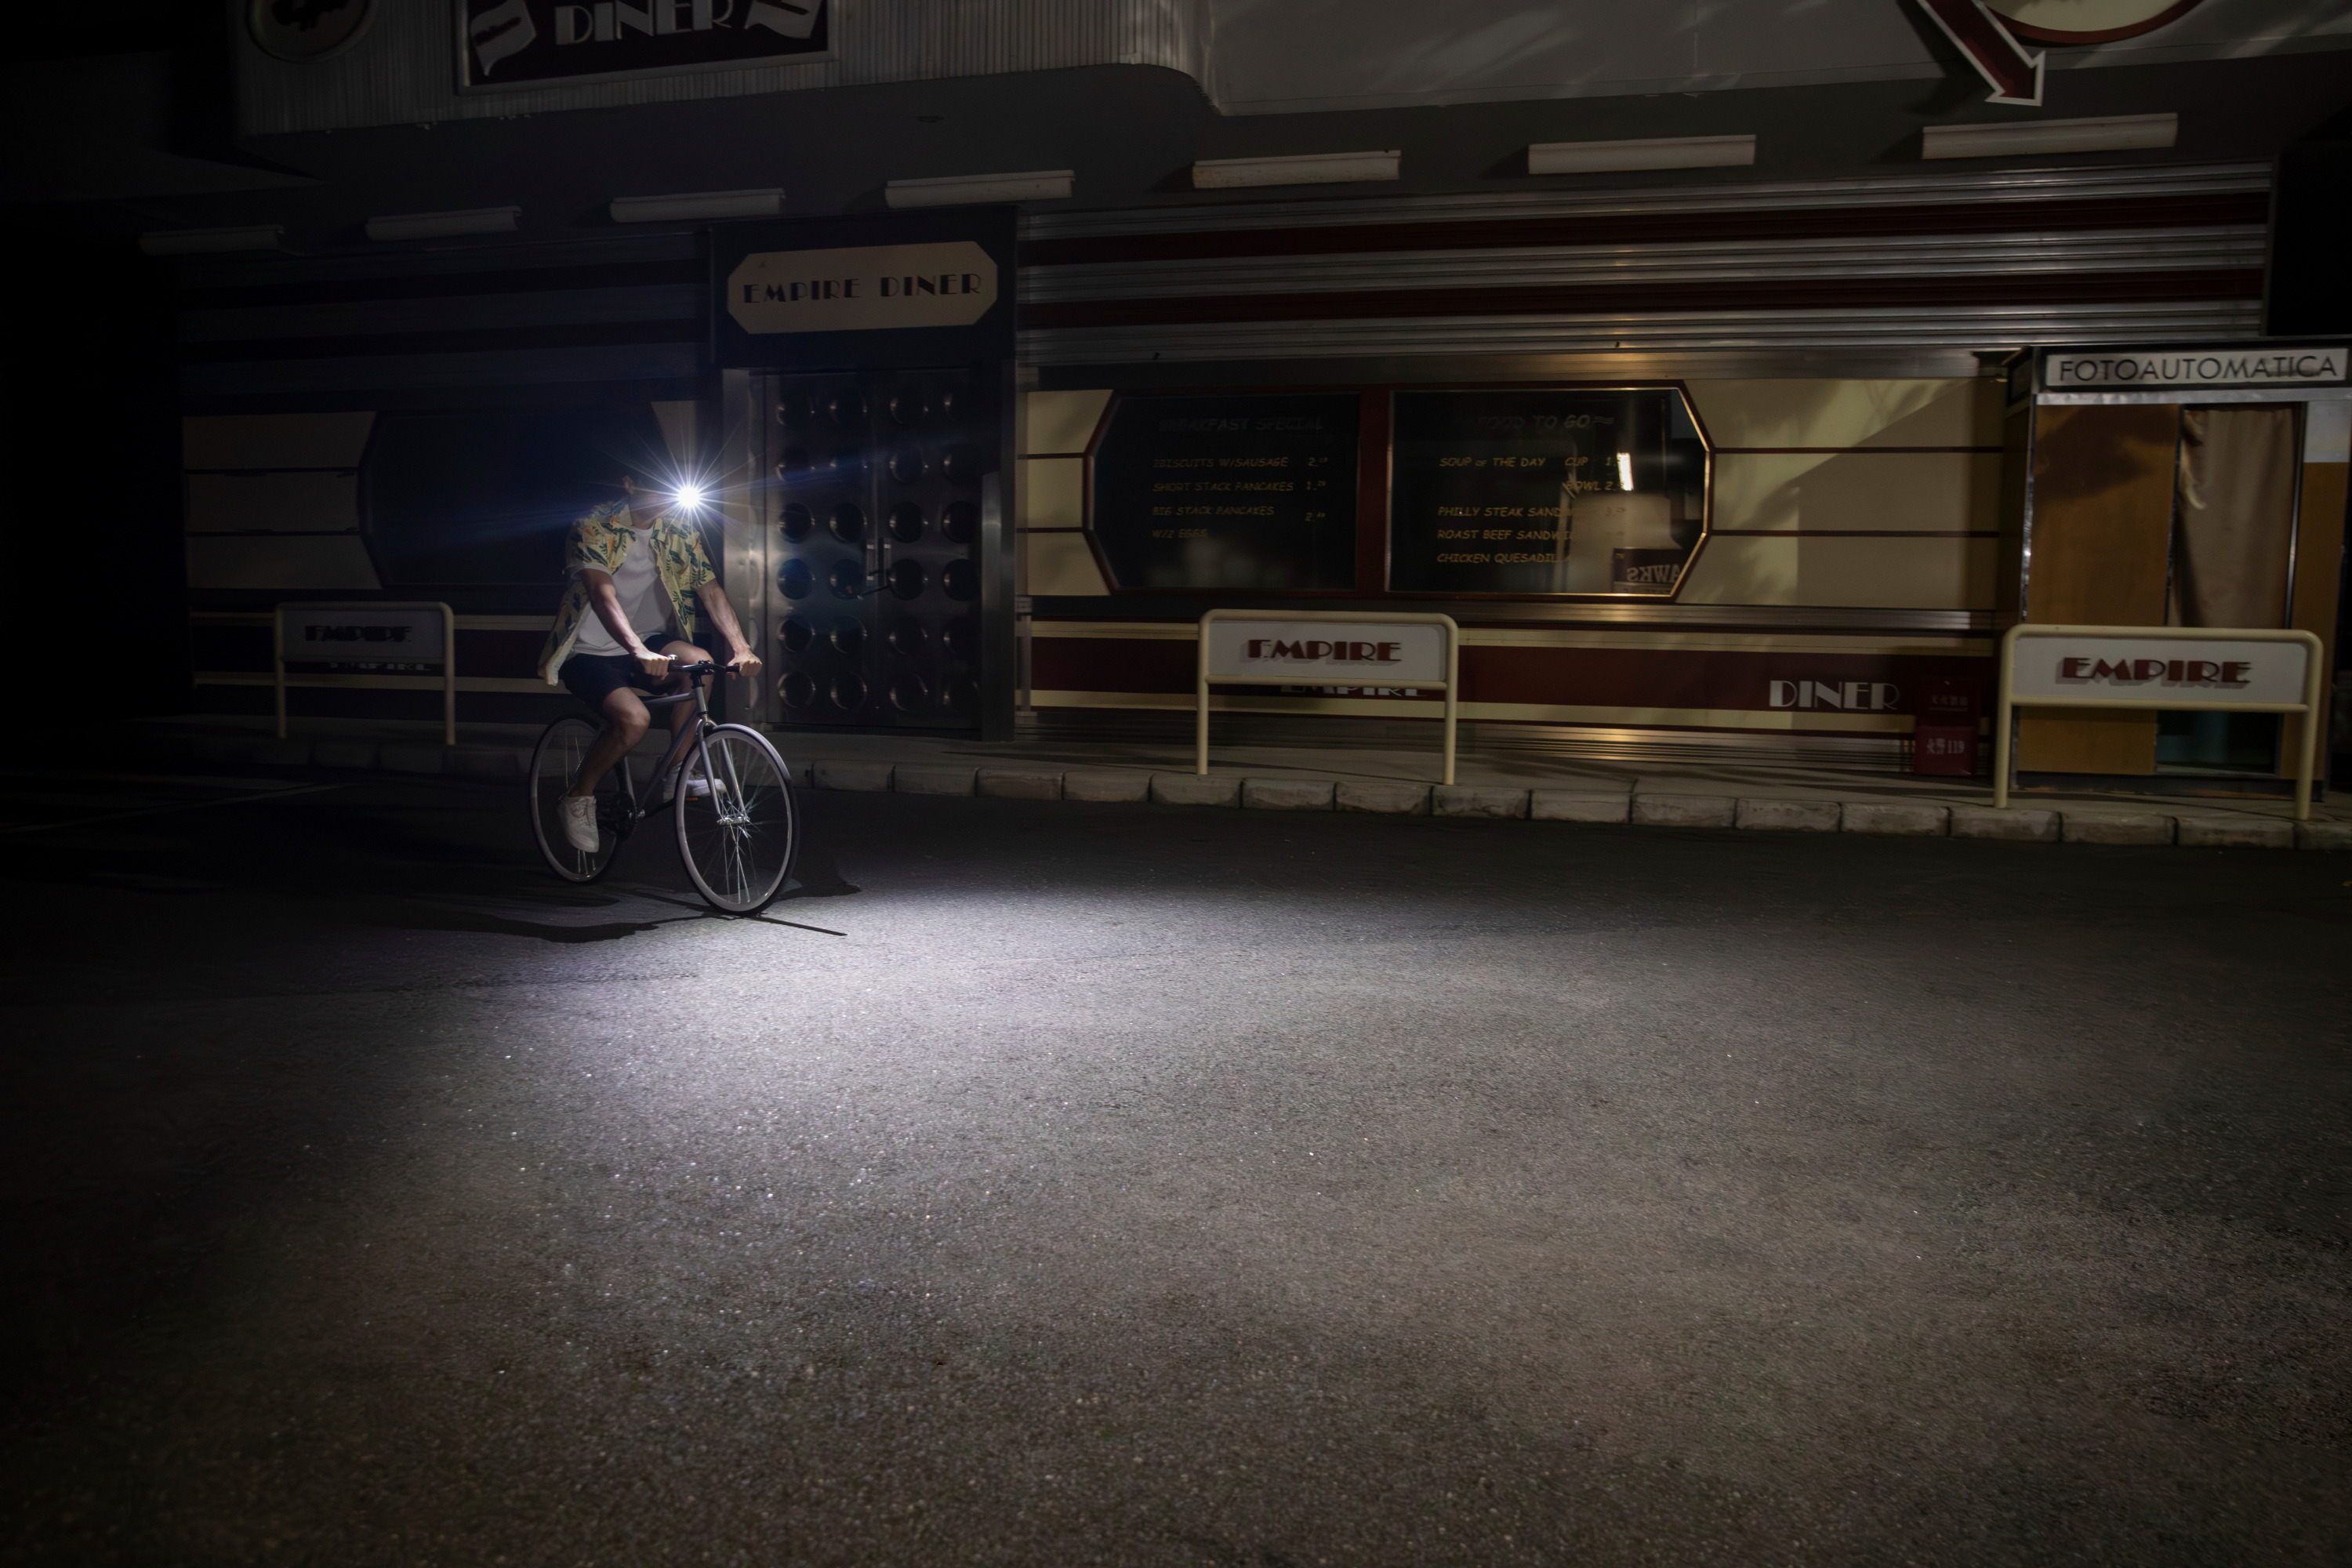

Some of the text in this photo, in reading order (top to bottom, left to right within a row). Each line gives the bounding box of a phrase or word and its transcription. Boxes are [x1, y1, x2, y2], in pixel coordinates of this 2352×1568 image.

[554, 0, 735, 45] DINER
[743, 274, 980, 303] EMPIRE DINER
[2060, 356, 2338, 381] FOTOAUTOMATICA
[1531, 415, 1559, 429] TO
[1563, 413, 1591, 428] GO
[1218, 457, 1290, 468] W/SAUSAGE
[1439, 457, 1472, 467] SOUP
[1493, 457, 1516, 467] THE
[1520, 457, 1547, 467] DAY
[1564, 457, 1589, 467] CUP
[1152, 481, 1294, 492] SHORT STACK PANCAKES
[1152, 506, 1172, 516] BIG
[1216, 506, 1276, 516] PANCAKES
[1437, 506, 1481, 517] PHILLY
[1483, 506, 1524, 517] STEAK
[1437, 529, 1480, 539] ROAST
[1482, 530, 1513, 539] BEEF
[1436, 553, 1490, 564] CHICKEN
[1247, 639, 1402, 662] EMPIRE
[2062, 656, 2252, 684] EMPIRE
[1769, 679, 1900, 711] DINER
